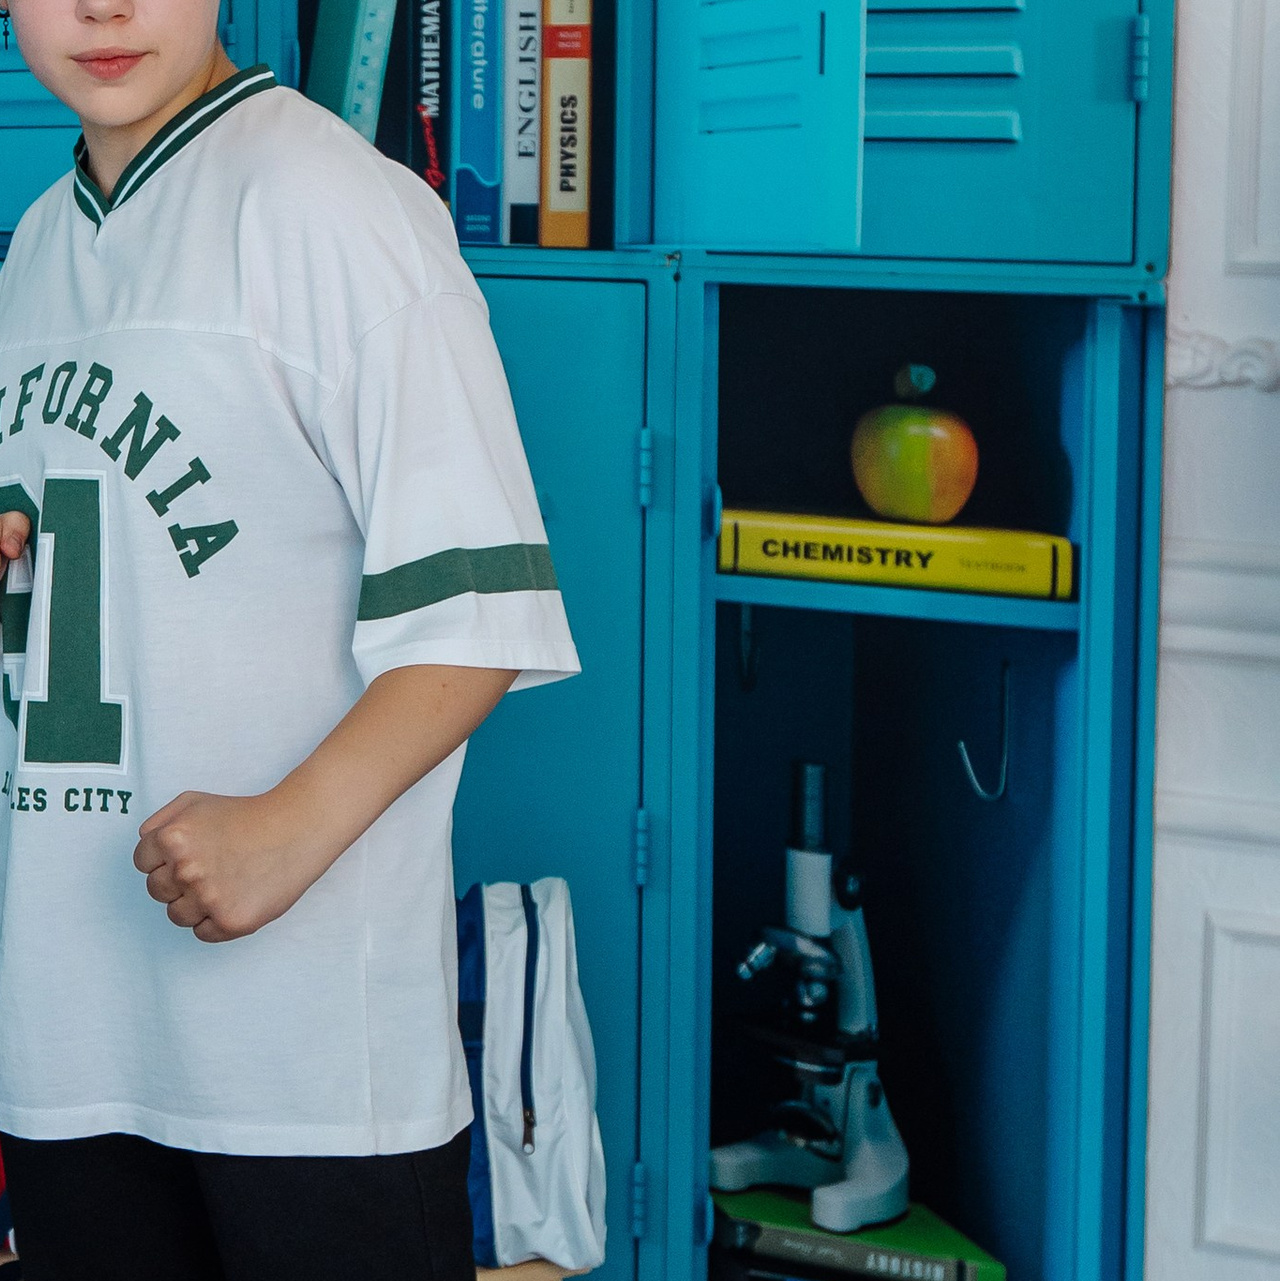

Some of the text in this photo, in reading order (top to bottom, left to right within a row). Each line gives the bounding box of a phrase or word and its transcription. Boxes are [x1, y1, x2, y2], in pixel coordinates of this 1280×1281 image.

[517, 11, 538, 160] ENGLISH
[559, 94, 579, 193] PHYSICS
[761, 538, 936, 570] CHEMISTRY
[64, 787, 133, 815] CITY
